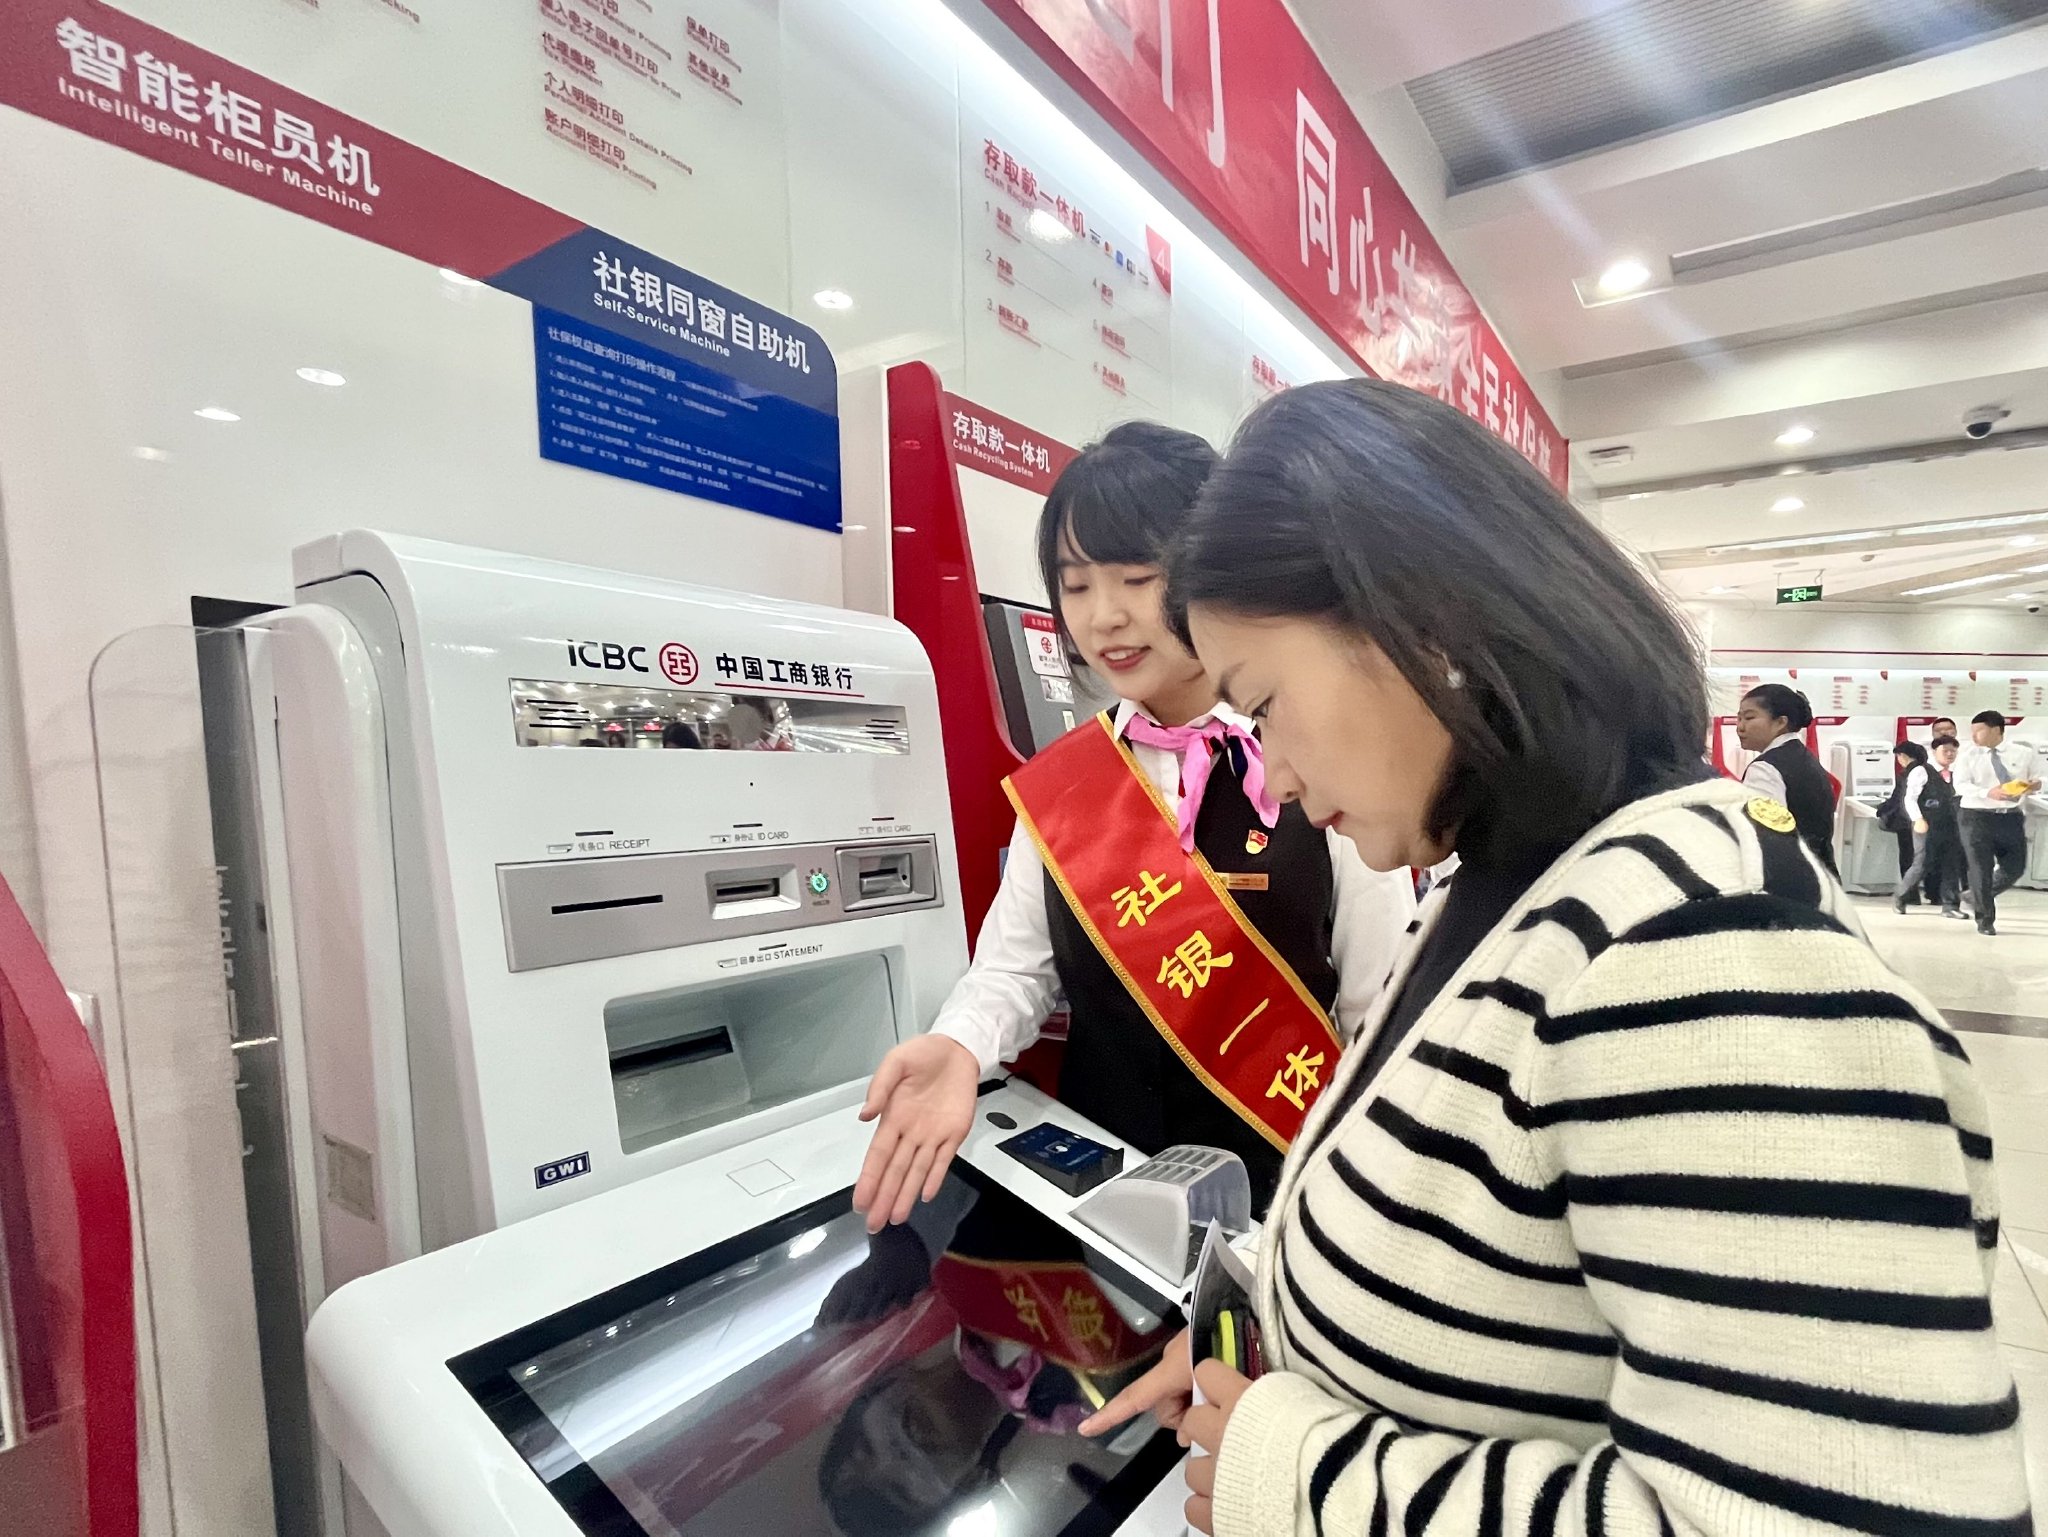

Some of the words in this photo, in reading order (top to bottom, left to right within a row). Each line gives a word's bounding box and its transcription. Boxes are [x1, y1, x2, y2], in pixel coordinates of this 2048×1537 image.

[56, 17, 381, 197] 智能柜员机
[58, 77, 200, 148] Intelligent
[206, 135, 275, 178] Teller
[282, 166, 375, 216] Machine
[660, 150, 693, 176] Printing
[622, 164, 657, 190] Printing
[984, 138, 1087, 239] 存取款一体机
[1156, 248, 1167, 276] 4
[593, 251, 811, 374] 社银同窗自助机
[593, 292, 677, 337] Self-Service
[679, 325, 731, 358] Machine
[953, 411, 1051, 474] 存取款一体机
[953, 439, 973, 454] Cash
[973, 446, 1009, 471] Recycling
[1009, 460, 1034, 478] System
[715, 653, 853, 690] 中国工商银行
[609, 838, 650, 850] RECEIPT
[757, 832, 766, 841] ID
[767, 831, 789, 841] CARD
[894, 824, 911, 833] CARD
[774, 943, 823, 960] STATEMENT
[1111, 870, 1325, 1111] 社银一体
[543, 1158, 584, 1181] GWI
